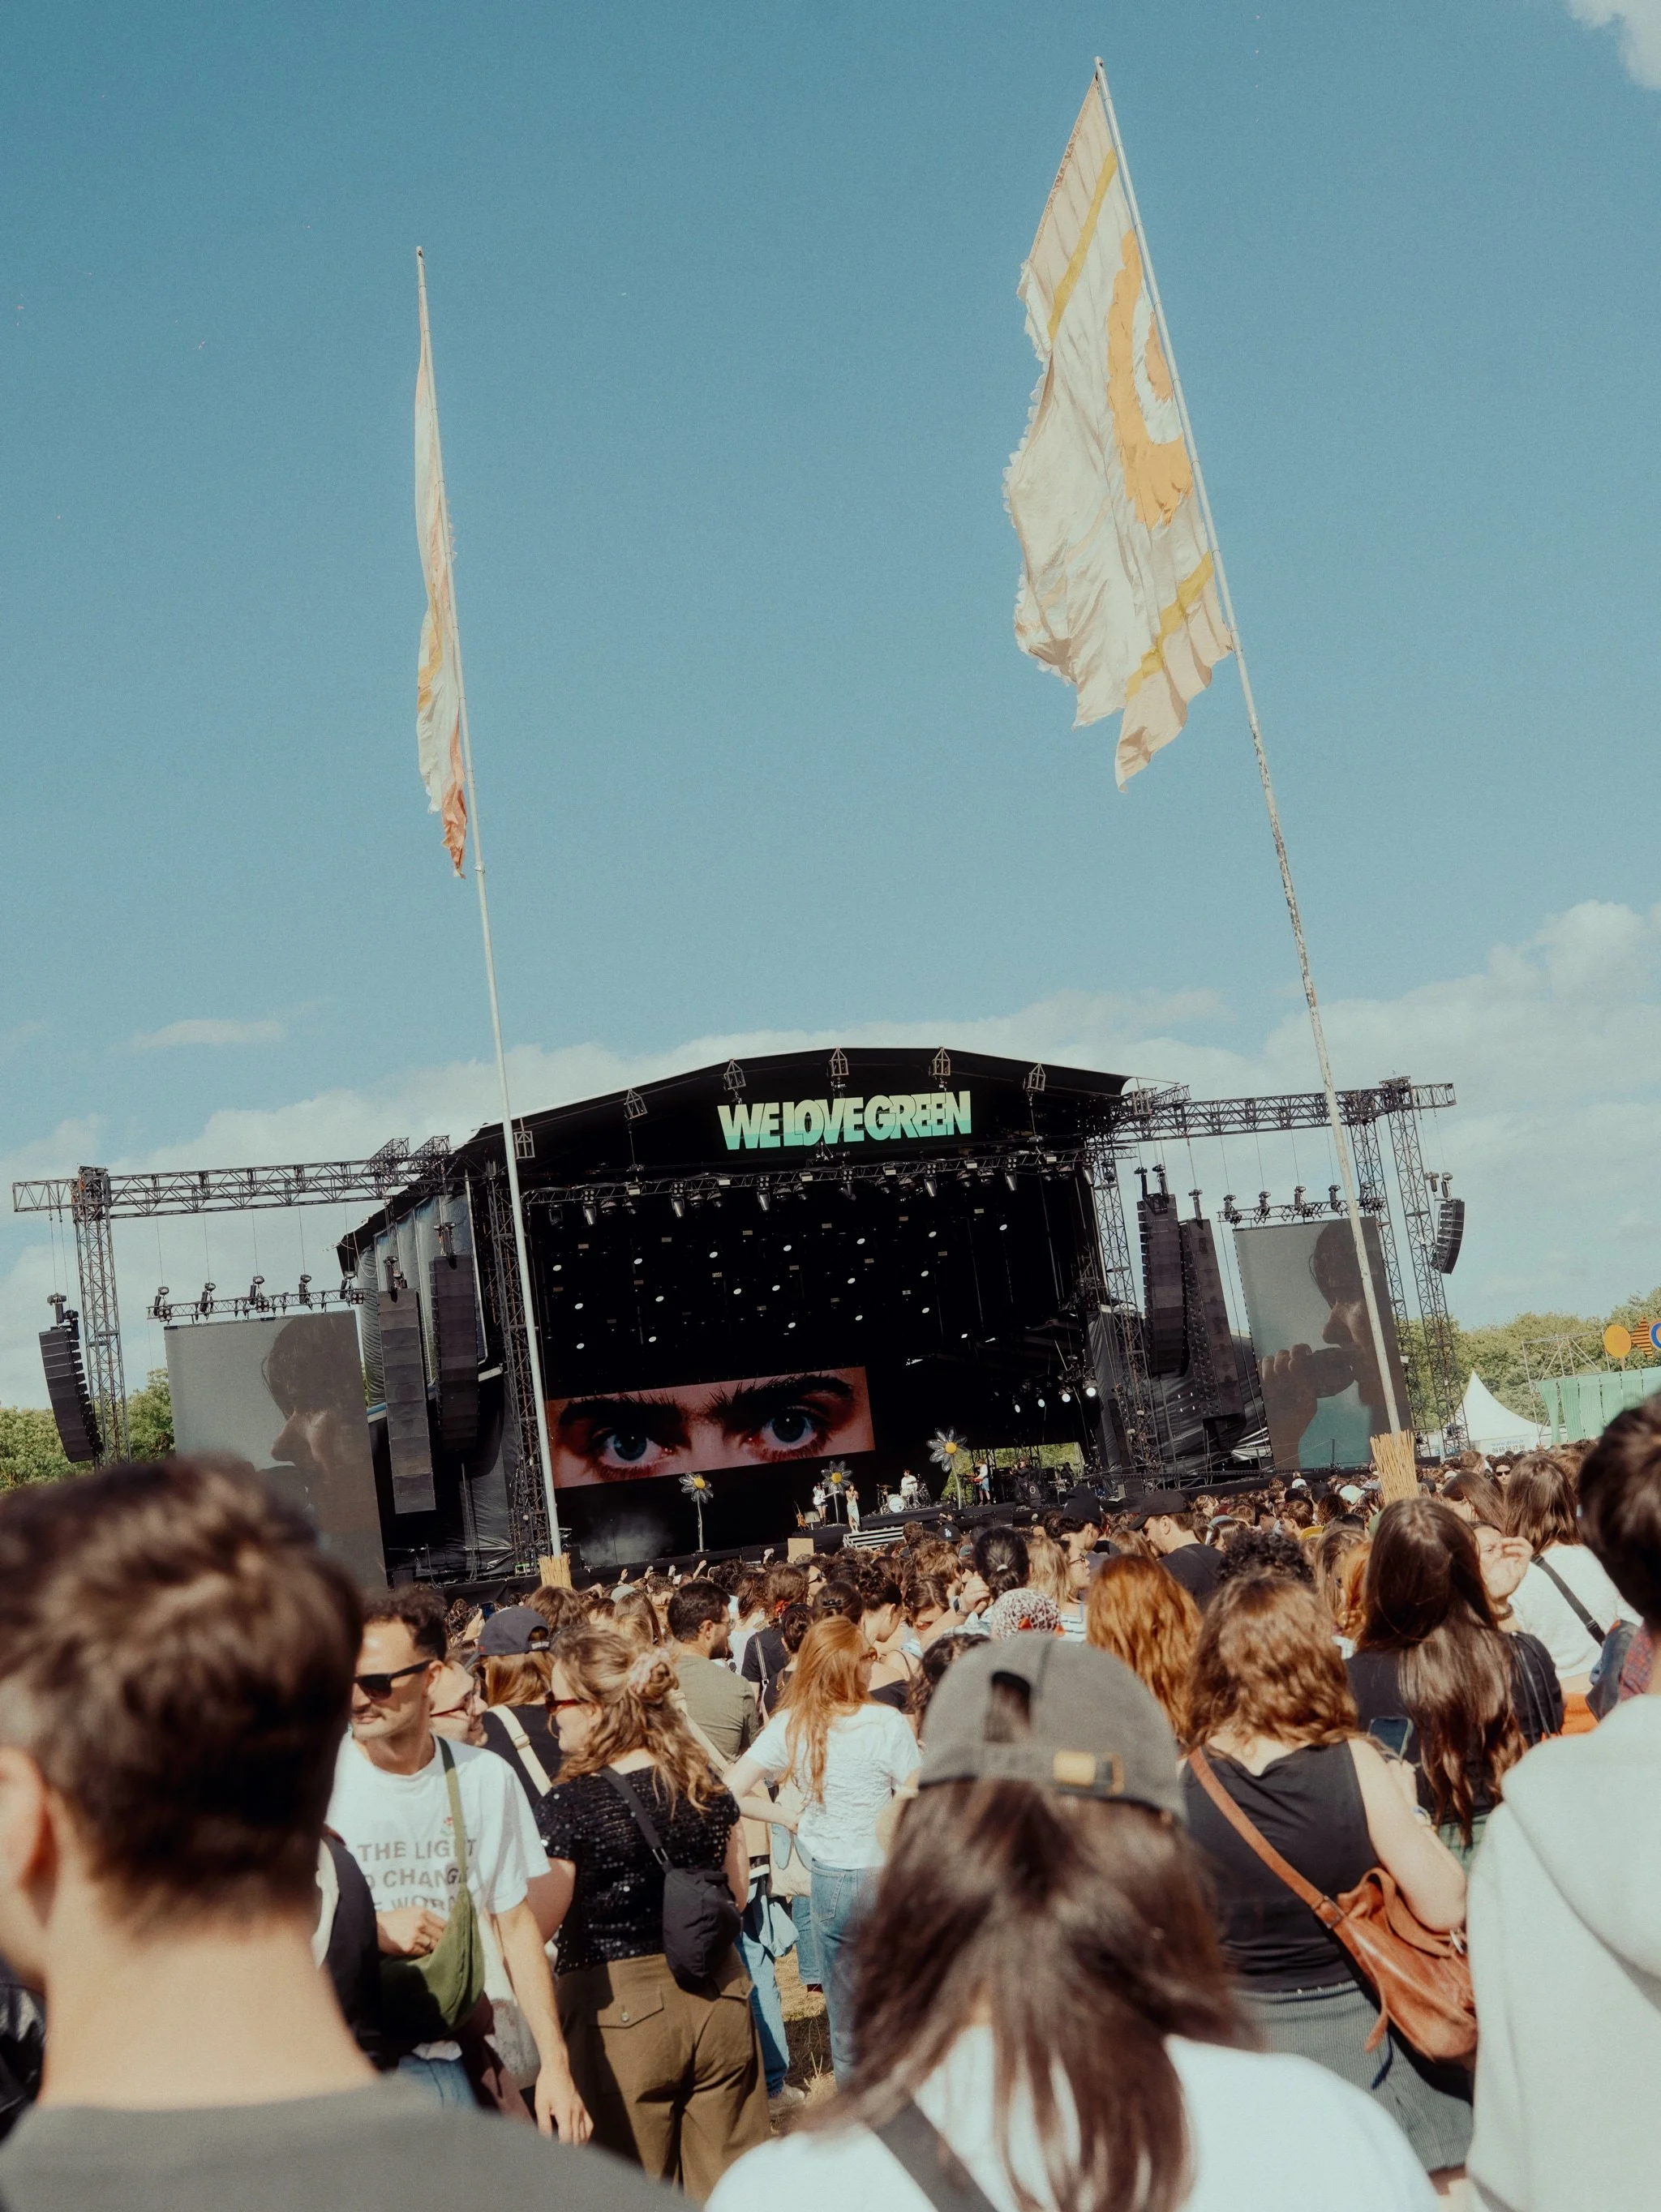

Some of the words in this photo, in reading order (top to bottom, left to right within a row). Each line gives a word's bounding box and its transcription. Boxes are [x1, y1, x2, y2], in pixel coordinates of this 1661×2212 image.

[358, 1841, 407, 1862] THE
[415, 1838, 477, 1859] LIGT
[384, 1867, 469, 1888] CHANG
